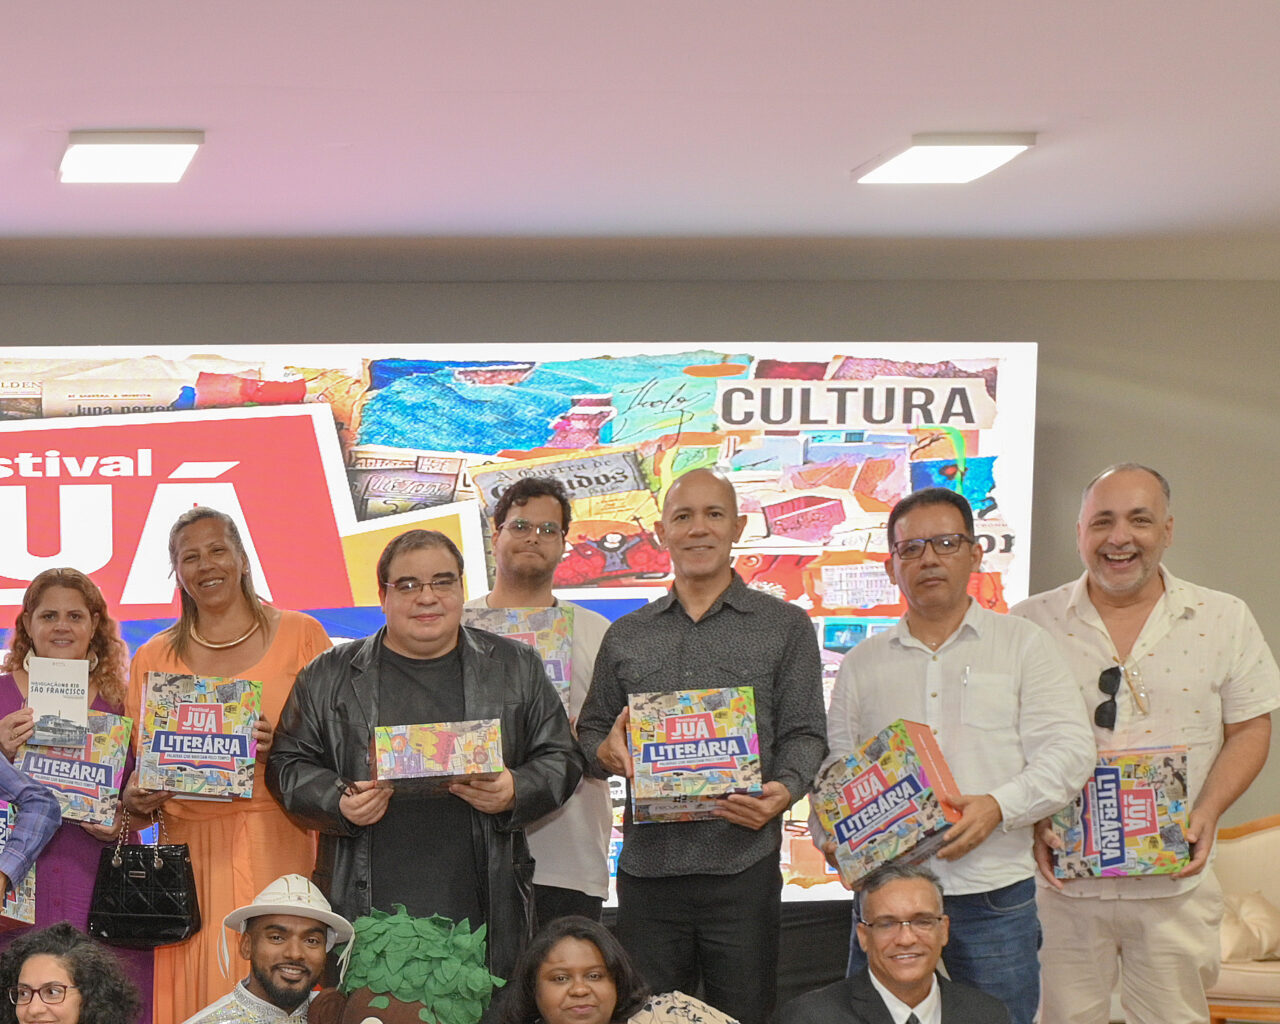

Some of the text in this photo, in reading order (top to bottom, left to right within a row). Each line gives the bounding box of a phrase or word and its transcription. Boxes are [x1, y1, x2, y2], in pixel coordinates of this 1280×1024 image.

[721, 386, 976, 425] CULTURA
[46, 687, 86, 696] FRANCISCO
[182, 710, 217, 732] JUÁ
[671, 718, 710, 740] JUÁ
[160, 735, 241, 755] LITERÁRIA
[649, 739, 740, 761] LITERÁRIA
[29, 756, 106, 784] LITERÁRIA
[851, 774, 885, 808] JUÁ
[840, 781, 916, 838] LITERÁRIA
[1096, 774, 1122, 860] LITERÁRIA
[1123, 794, 1151, 832] JUÁ
